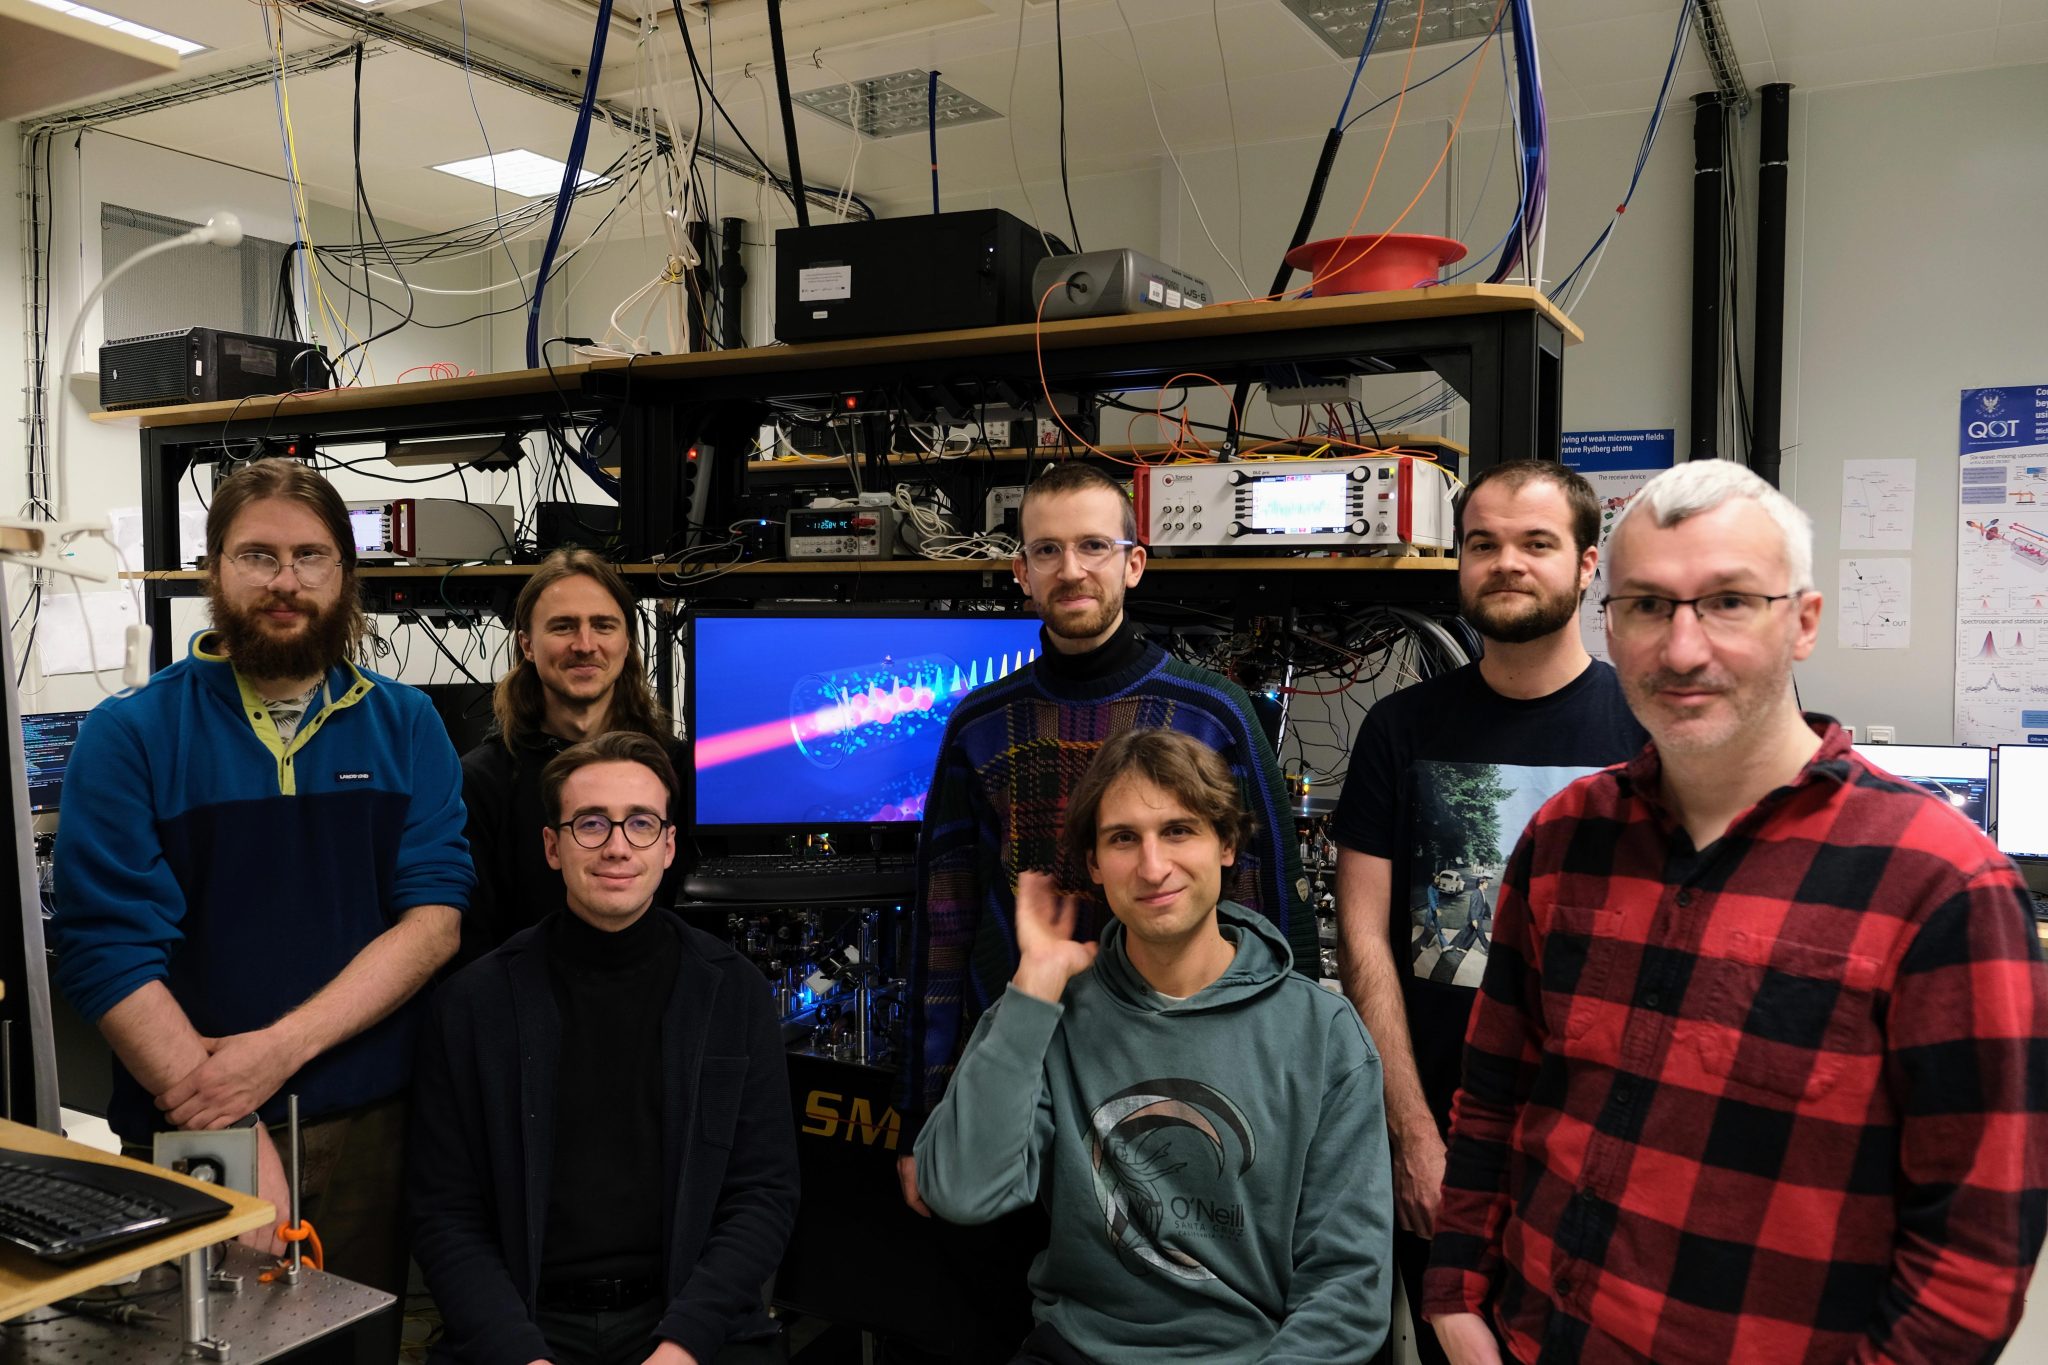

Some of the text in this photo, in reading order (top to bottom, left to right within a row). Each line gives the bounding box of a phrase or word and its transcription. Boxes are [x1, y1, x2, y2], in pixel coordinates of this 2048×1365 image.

[1183, 286, 1207, 302] WS-6
[1968, 420, 2020, 439] QOT
[1561, 433, 1665, 444] lving of weak microwave fields
[1582, 445, 1611, 454] Rydberg
[1611, 444, 1633, 452] atoms
[1170, 1196, 1245, 1228] O'Neill
[1212, 1224, 1244, 1237] CRUZ
